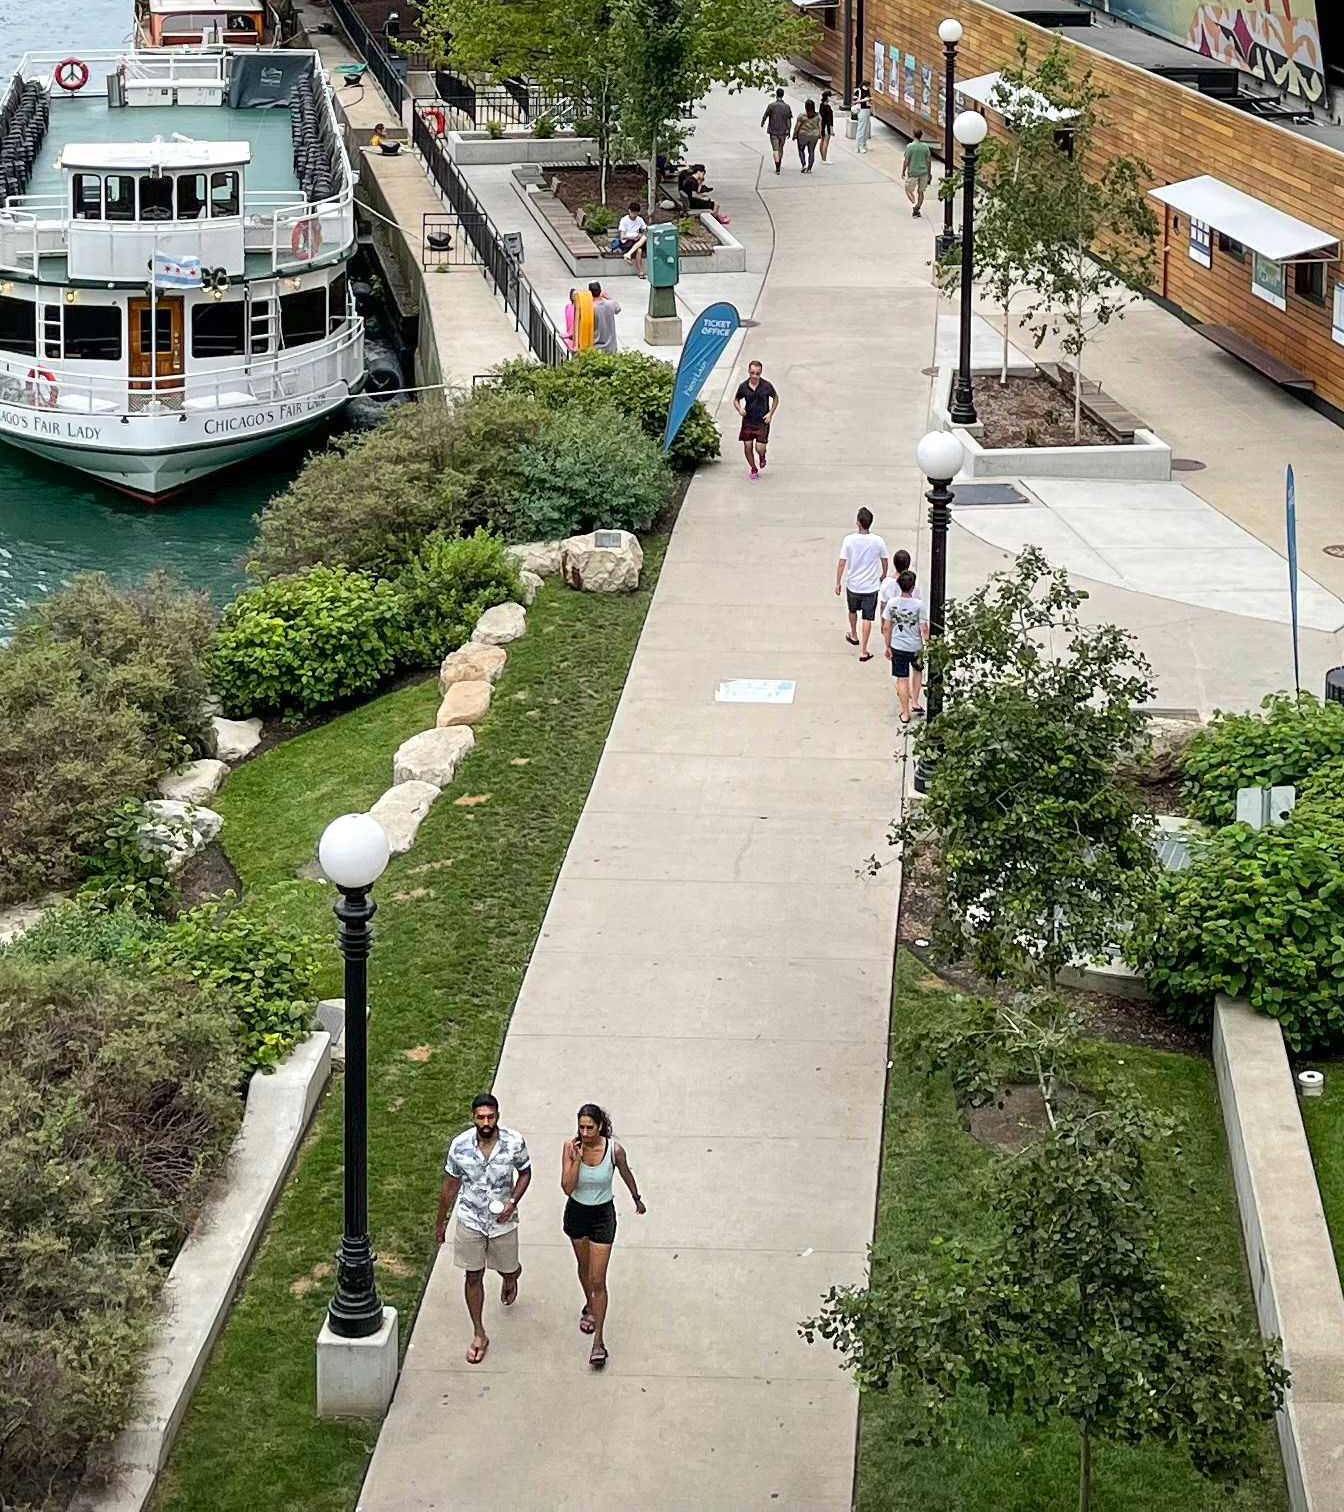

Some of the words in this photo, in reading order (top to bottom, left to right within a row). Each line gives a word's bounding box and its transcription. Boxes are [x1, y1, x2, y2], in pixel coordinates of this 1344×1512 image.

[703, 318, 732, 329] TICKET
[700, 327, 731, 337] OFFICE
[68, 422, 102, 440] LADY
